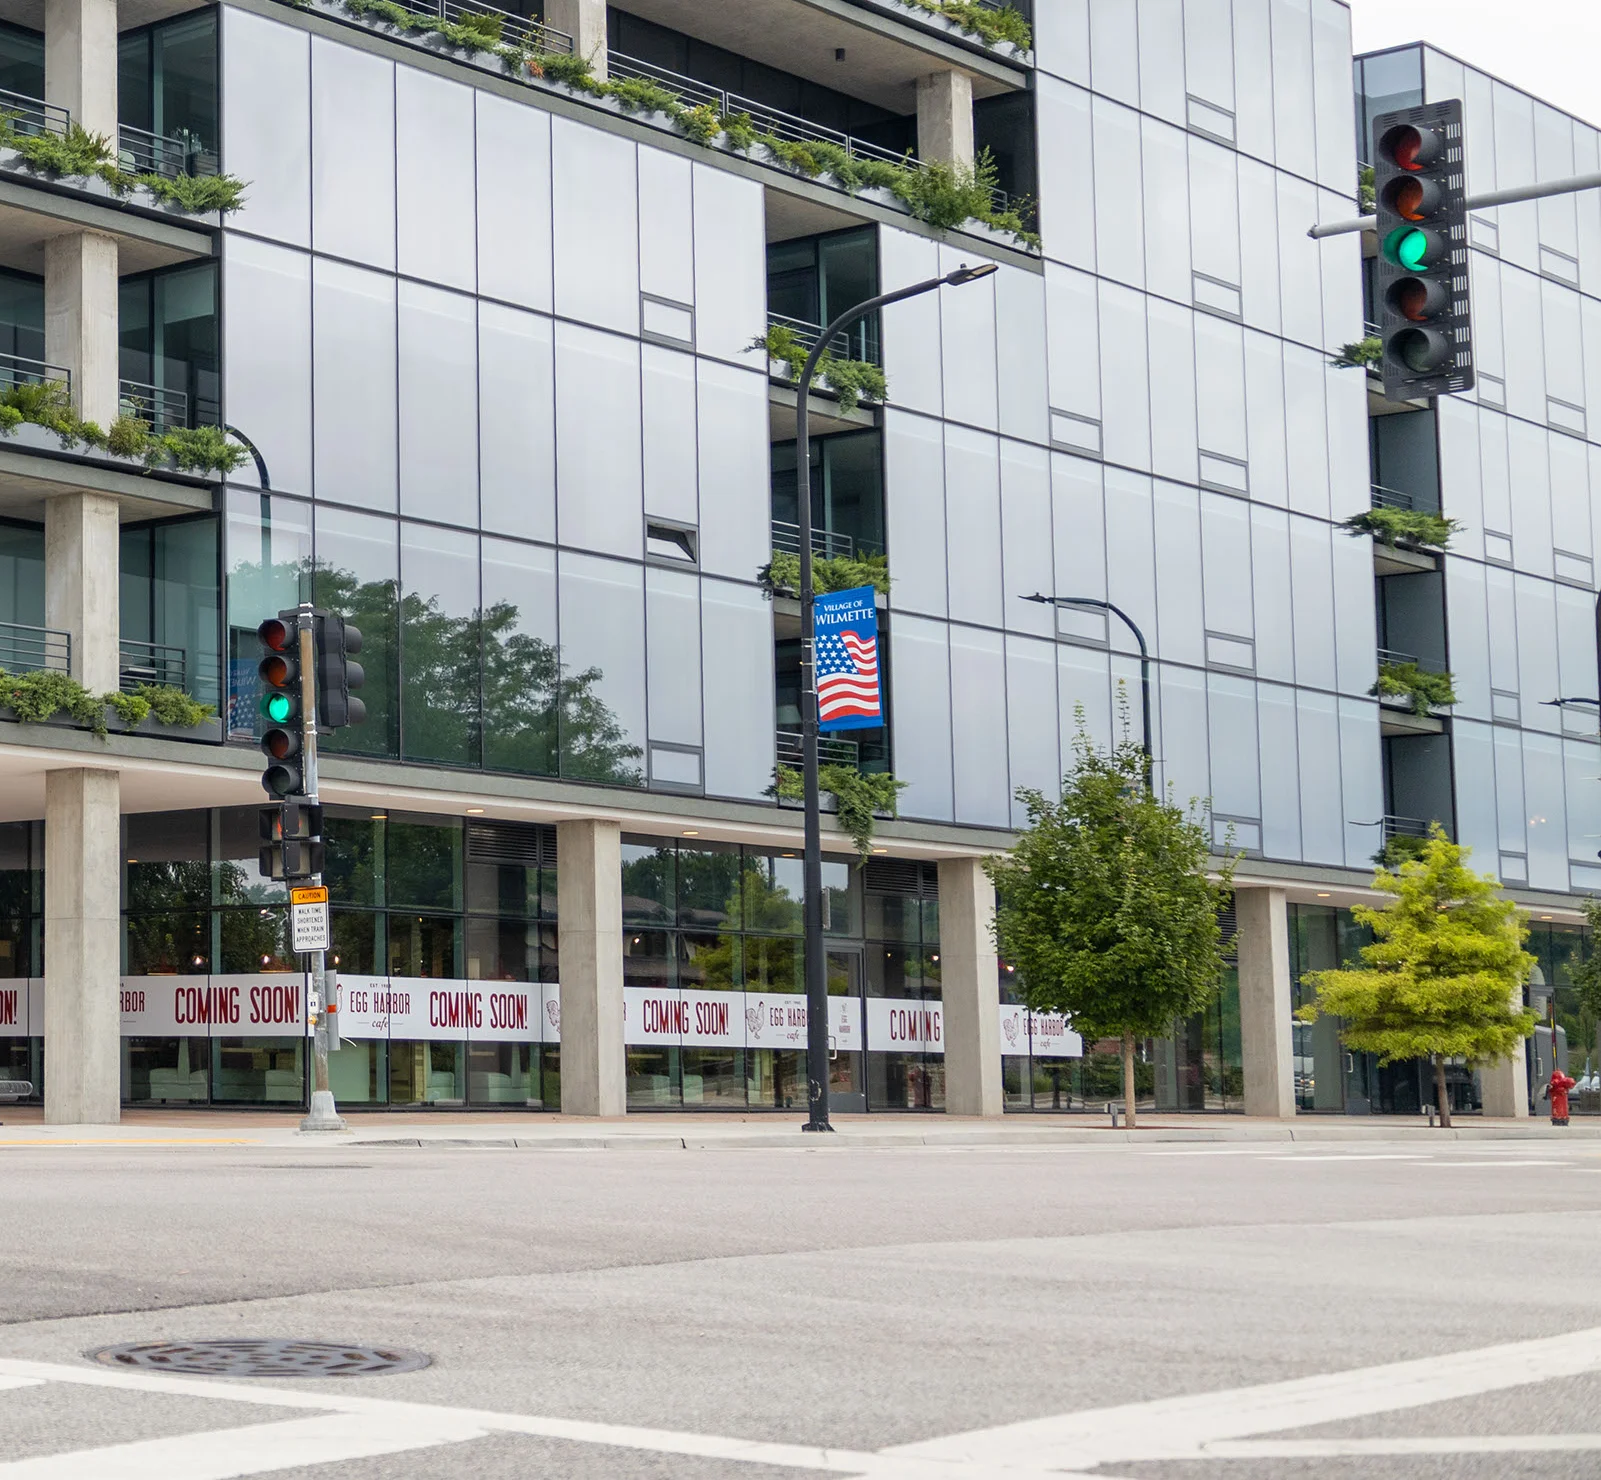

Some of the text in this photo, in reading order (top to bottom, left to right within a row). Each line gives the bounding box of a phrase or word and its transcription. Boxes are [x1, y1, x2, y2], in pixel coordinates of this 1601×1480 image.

[824, 599, 864, 611] VILLAGE OF
[815, 608, 874, 625] WILMETTE
[298, 892, 321, 901] CAUTION
[311, 906, 322, 914] TIME
[310, 925, 324, 933] TRAIN
[296, 934, 326, 943] APPROACHES
[120, 990, 146, 1013] RBOR
[175, 985, 301, 1025] COMING SOON!
[349, 991, 411, 1015] EGG HARBOR
[429, 991, 529, 1030] COMING SOON!
[643, 999, 690, 1034] COMING
[695, 1001, 730, 1036] SOON!
[769, 1007, 807, 1028] EGG HARB
[371, 1019, 389, 1032] cafe
[890, 1009, 940, 1043] COMING
[786, 1029, 800, 1042] cafe
[1039, 1038, 1051, 1050] cafe
